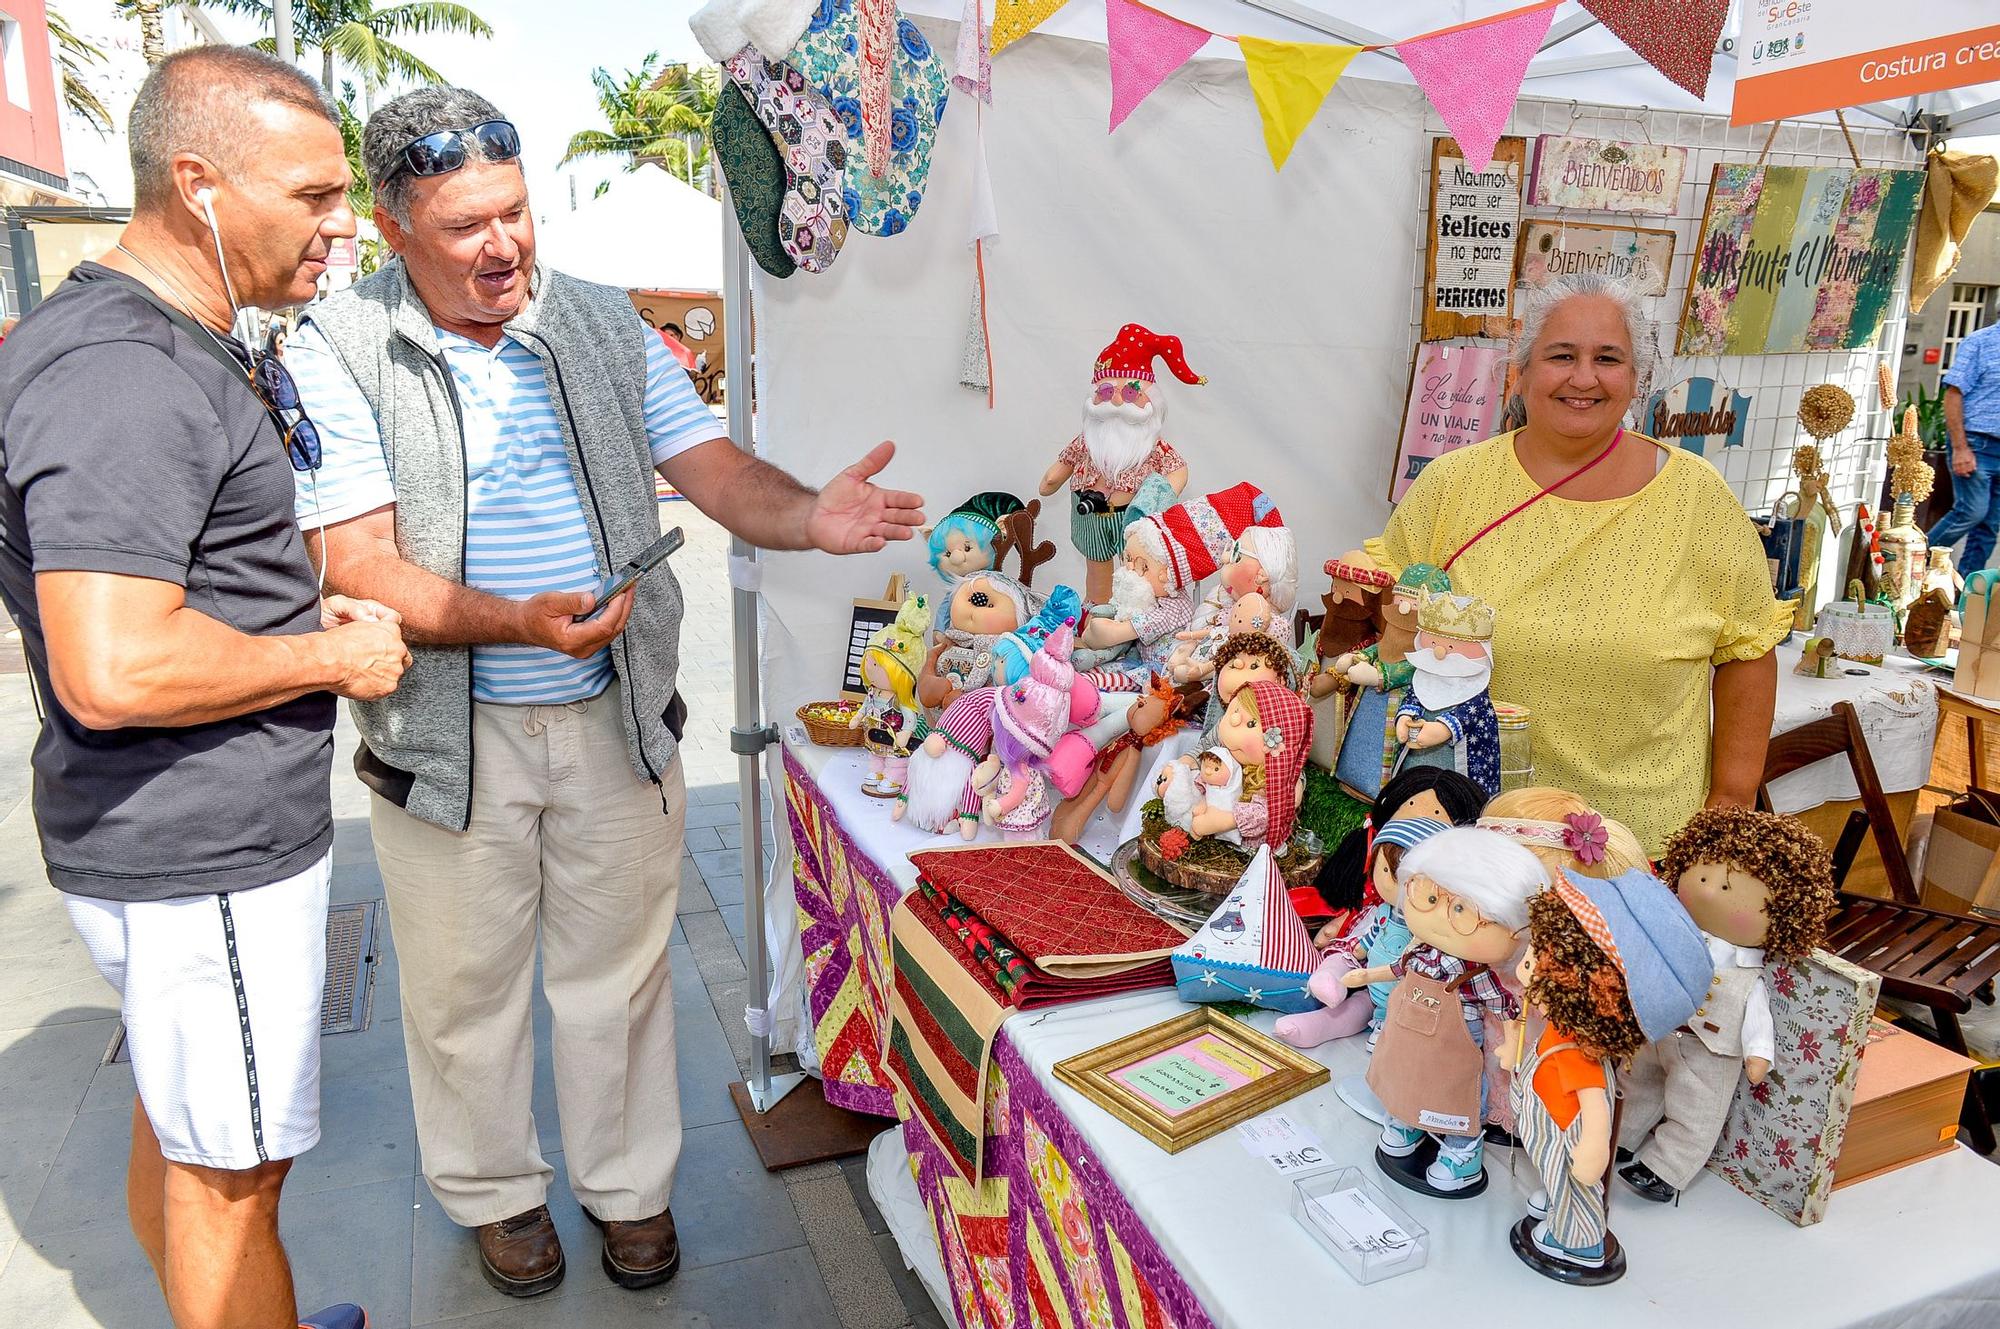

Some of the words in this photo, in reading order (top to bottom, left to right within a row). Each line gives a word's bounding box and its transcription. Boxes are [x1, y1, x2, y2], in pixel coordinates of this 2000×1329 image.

[1860, 52, 1947, 83] Costura
[1454, 165, 1506, 188] Nacimos
[1563, 160, 1665, 194] BIENVENIDOS
[1450, 194, 1477, 210] para
[1487, 195, 1502, 208] ser
[1441, 214, 1511, 238] felices
[1451, 245, 1466, 260] no
[1473, 246, 1502, 263] para
[1703, 229, 1792, 294] Disfruta
[1463, 267, 1479, 280] ser
[1436, 287, 1506, 308] PERFECTOS
[1421, 372, 1452, 410] La
[1450, 378, 1477, 404] vida
[1420, 412, 1440, 427] UN
[1444, 415, 1480, 432] VIAJE
[1431, 433, 1445, 443] no
[1448, 434, 1464, 444] un
